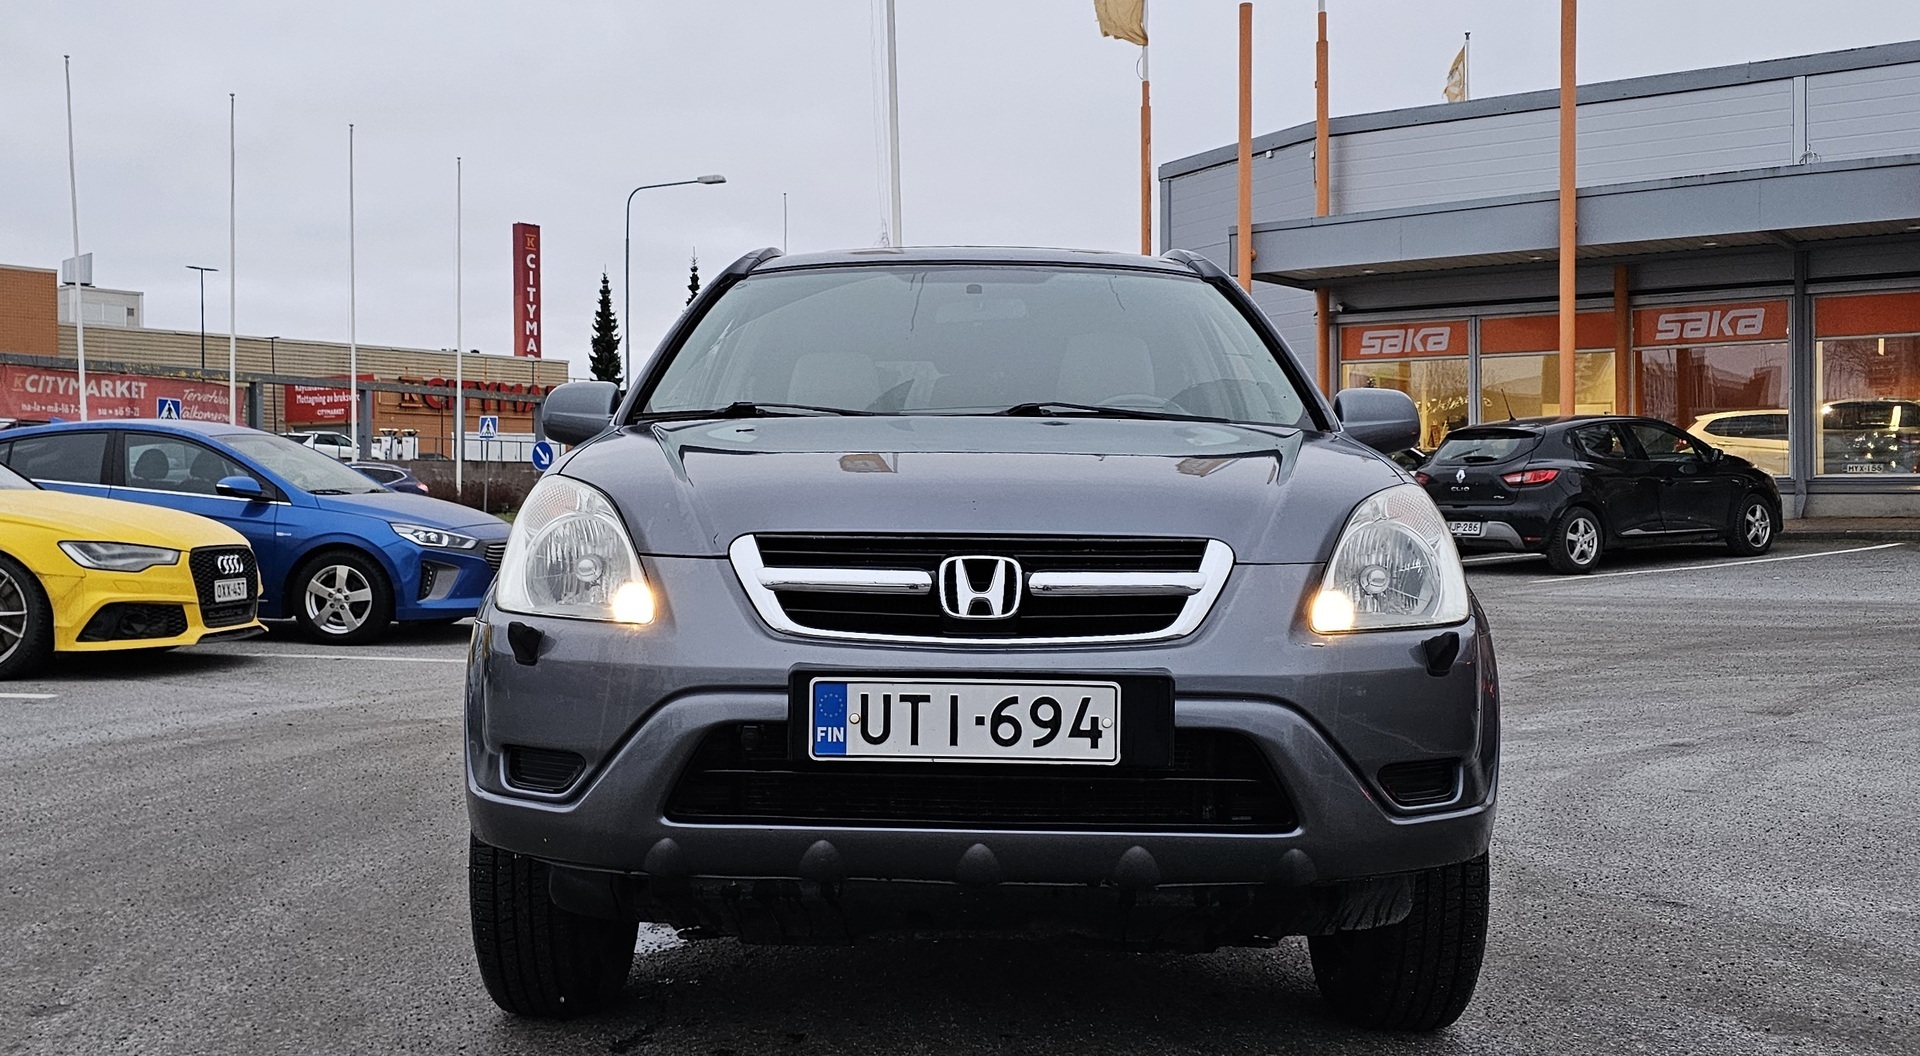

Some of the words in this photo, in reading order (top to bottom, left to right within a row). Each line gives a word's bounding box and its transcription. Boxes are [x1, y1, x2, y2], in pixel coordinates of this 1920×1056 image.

[526, 254, 538, 359] CITYMA
[425, 378, 556, 412] CITYMA
[816, 726, 844, 742] FIN
[860, 693, 1103, 750] UTI-694
